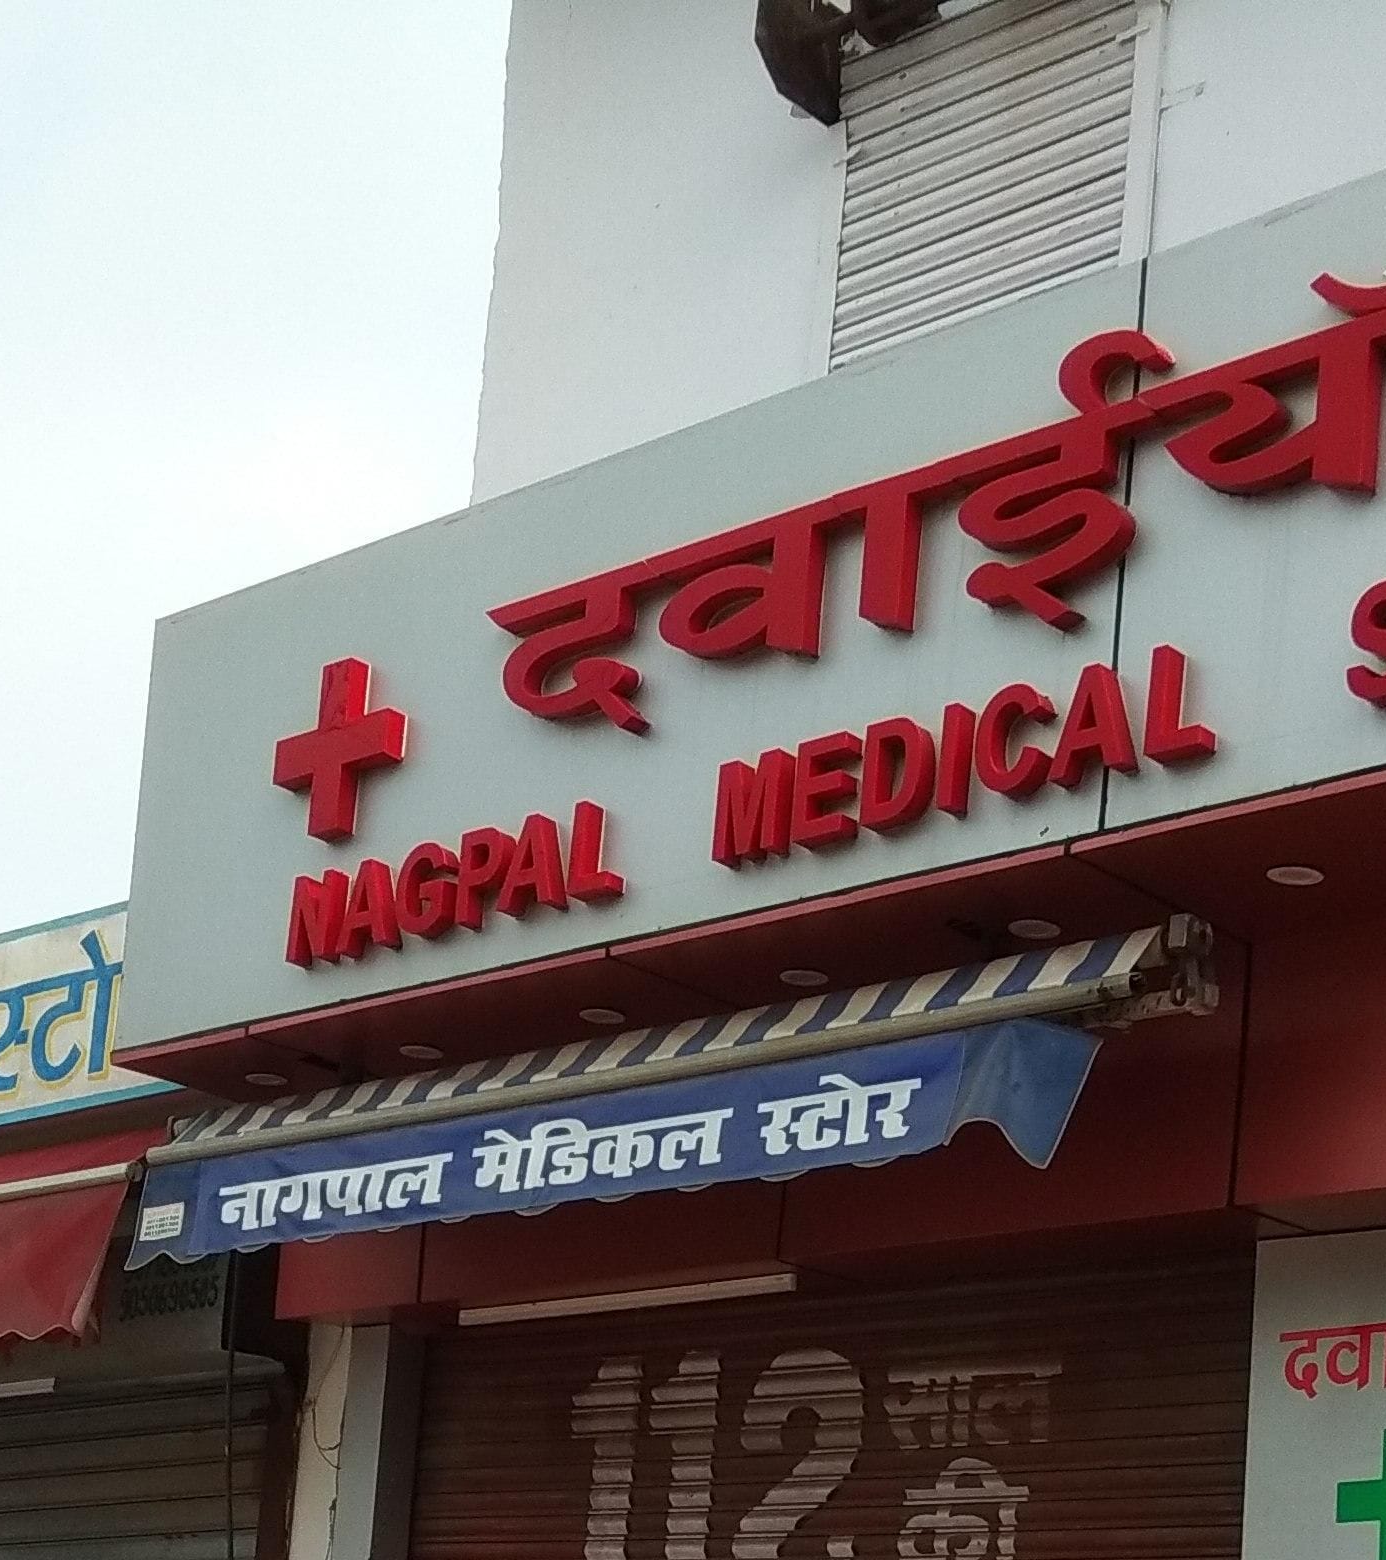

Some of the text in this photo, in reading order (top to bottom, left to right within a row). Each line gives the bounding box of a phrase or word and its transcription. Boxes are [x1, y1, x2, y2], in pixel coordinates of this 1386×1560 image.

[285, 799, 626, 970] NAGPAL
[711, 643, 1217, 870] MEDICAL
[218, 1074, 922, 1233] नागपाल मेडिकल स्टोर
[883, 1358, 1063, 1450] साल
